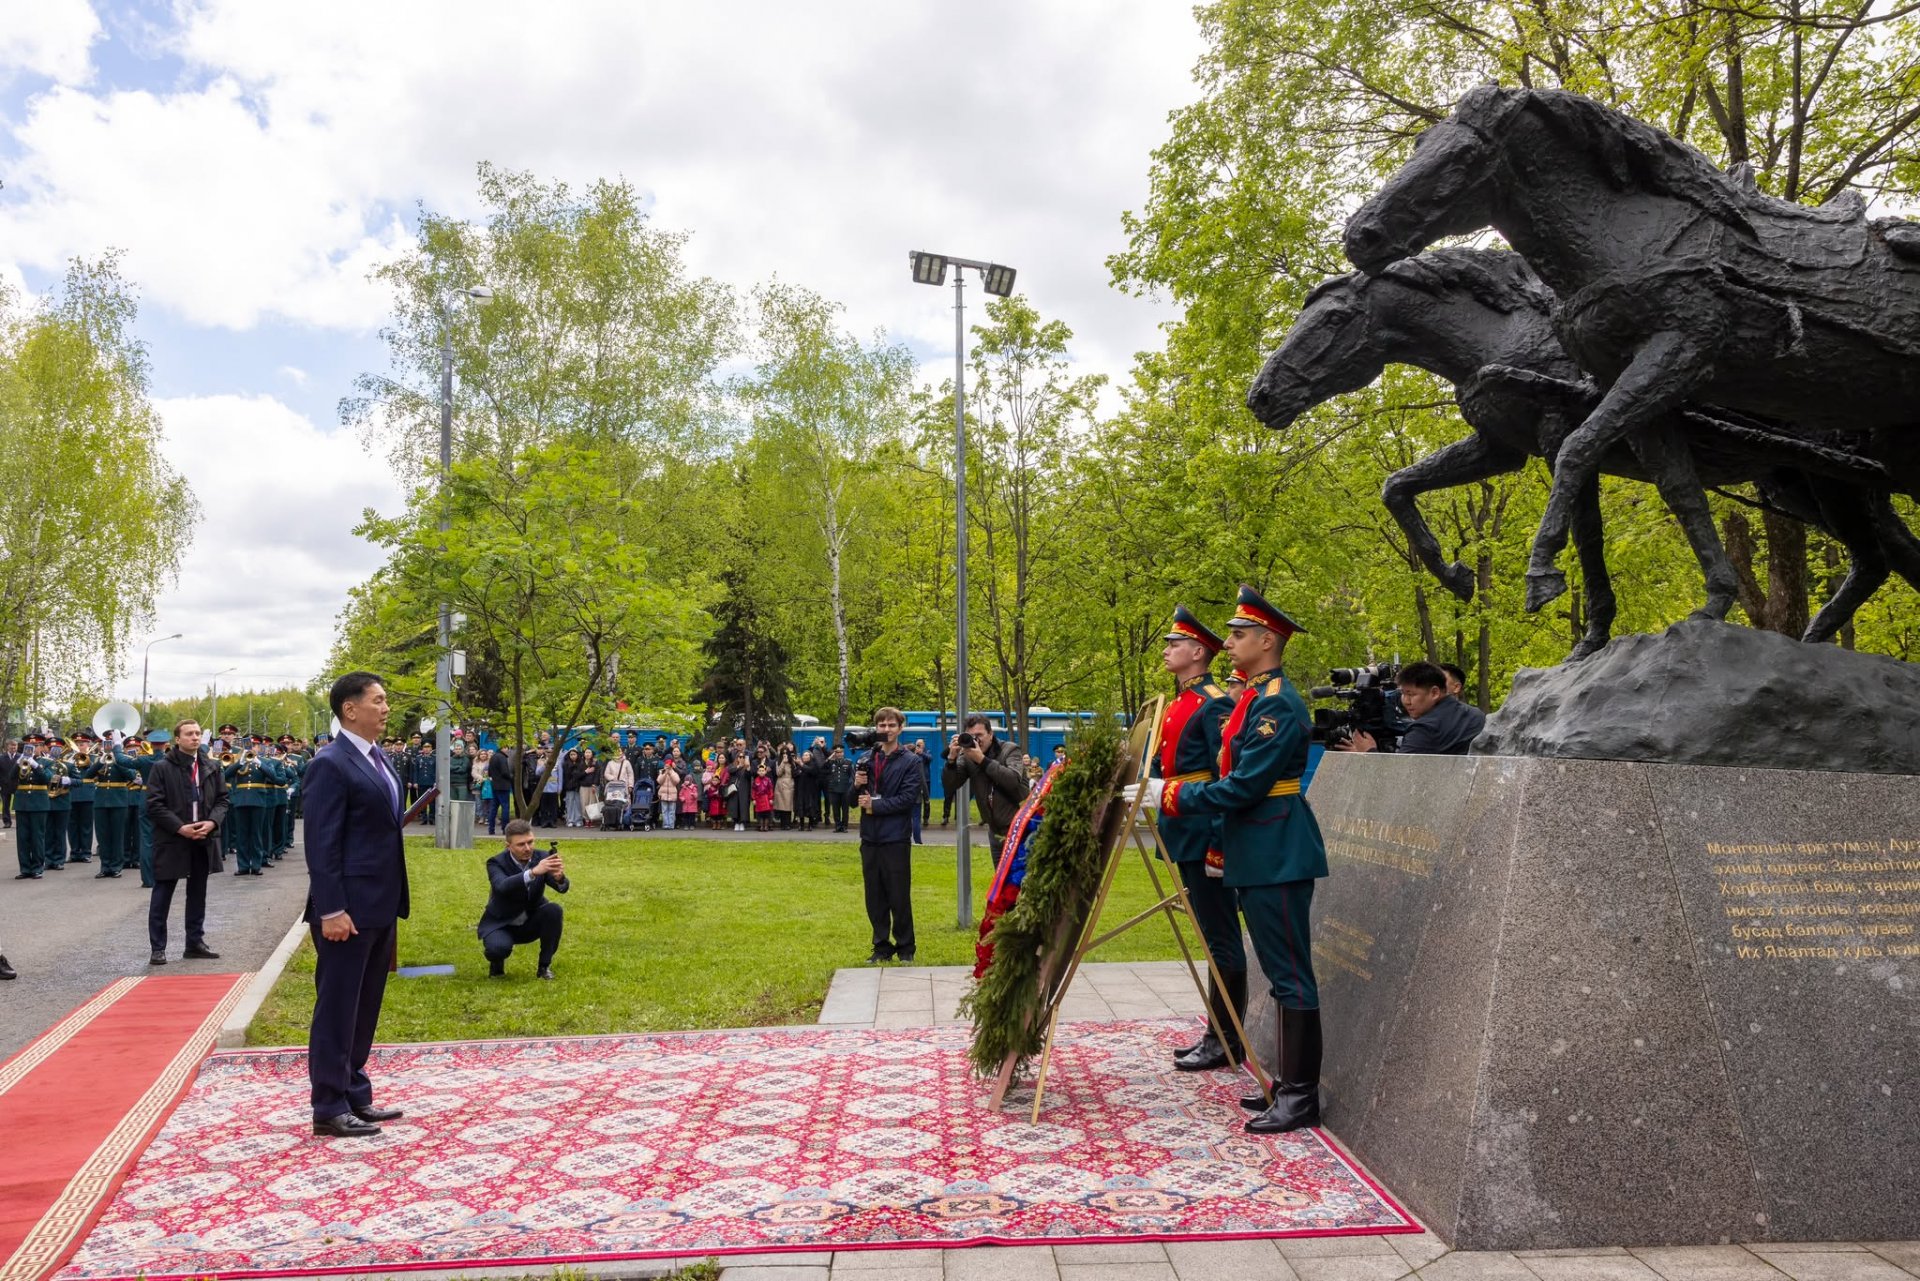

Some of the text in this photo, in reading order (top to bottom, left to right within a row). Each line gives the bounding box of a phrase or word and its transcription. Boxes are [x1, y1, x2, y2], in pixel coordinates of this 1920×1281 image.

[1706, 841, 1793, 855] Монголын
[1890, 838, 1920, 854] Ауг
[1725, 905, 1775, 917] нисэх
[1780, 903, 1854, 917] онгоцны
[1731, 923, 1783, 941] бусад
[1737, 945, 1762, 960] Их
[1765, 944, 1839, 959] Ялалтад
[1843, 945, 1883, 960] хувь
